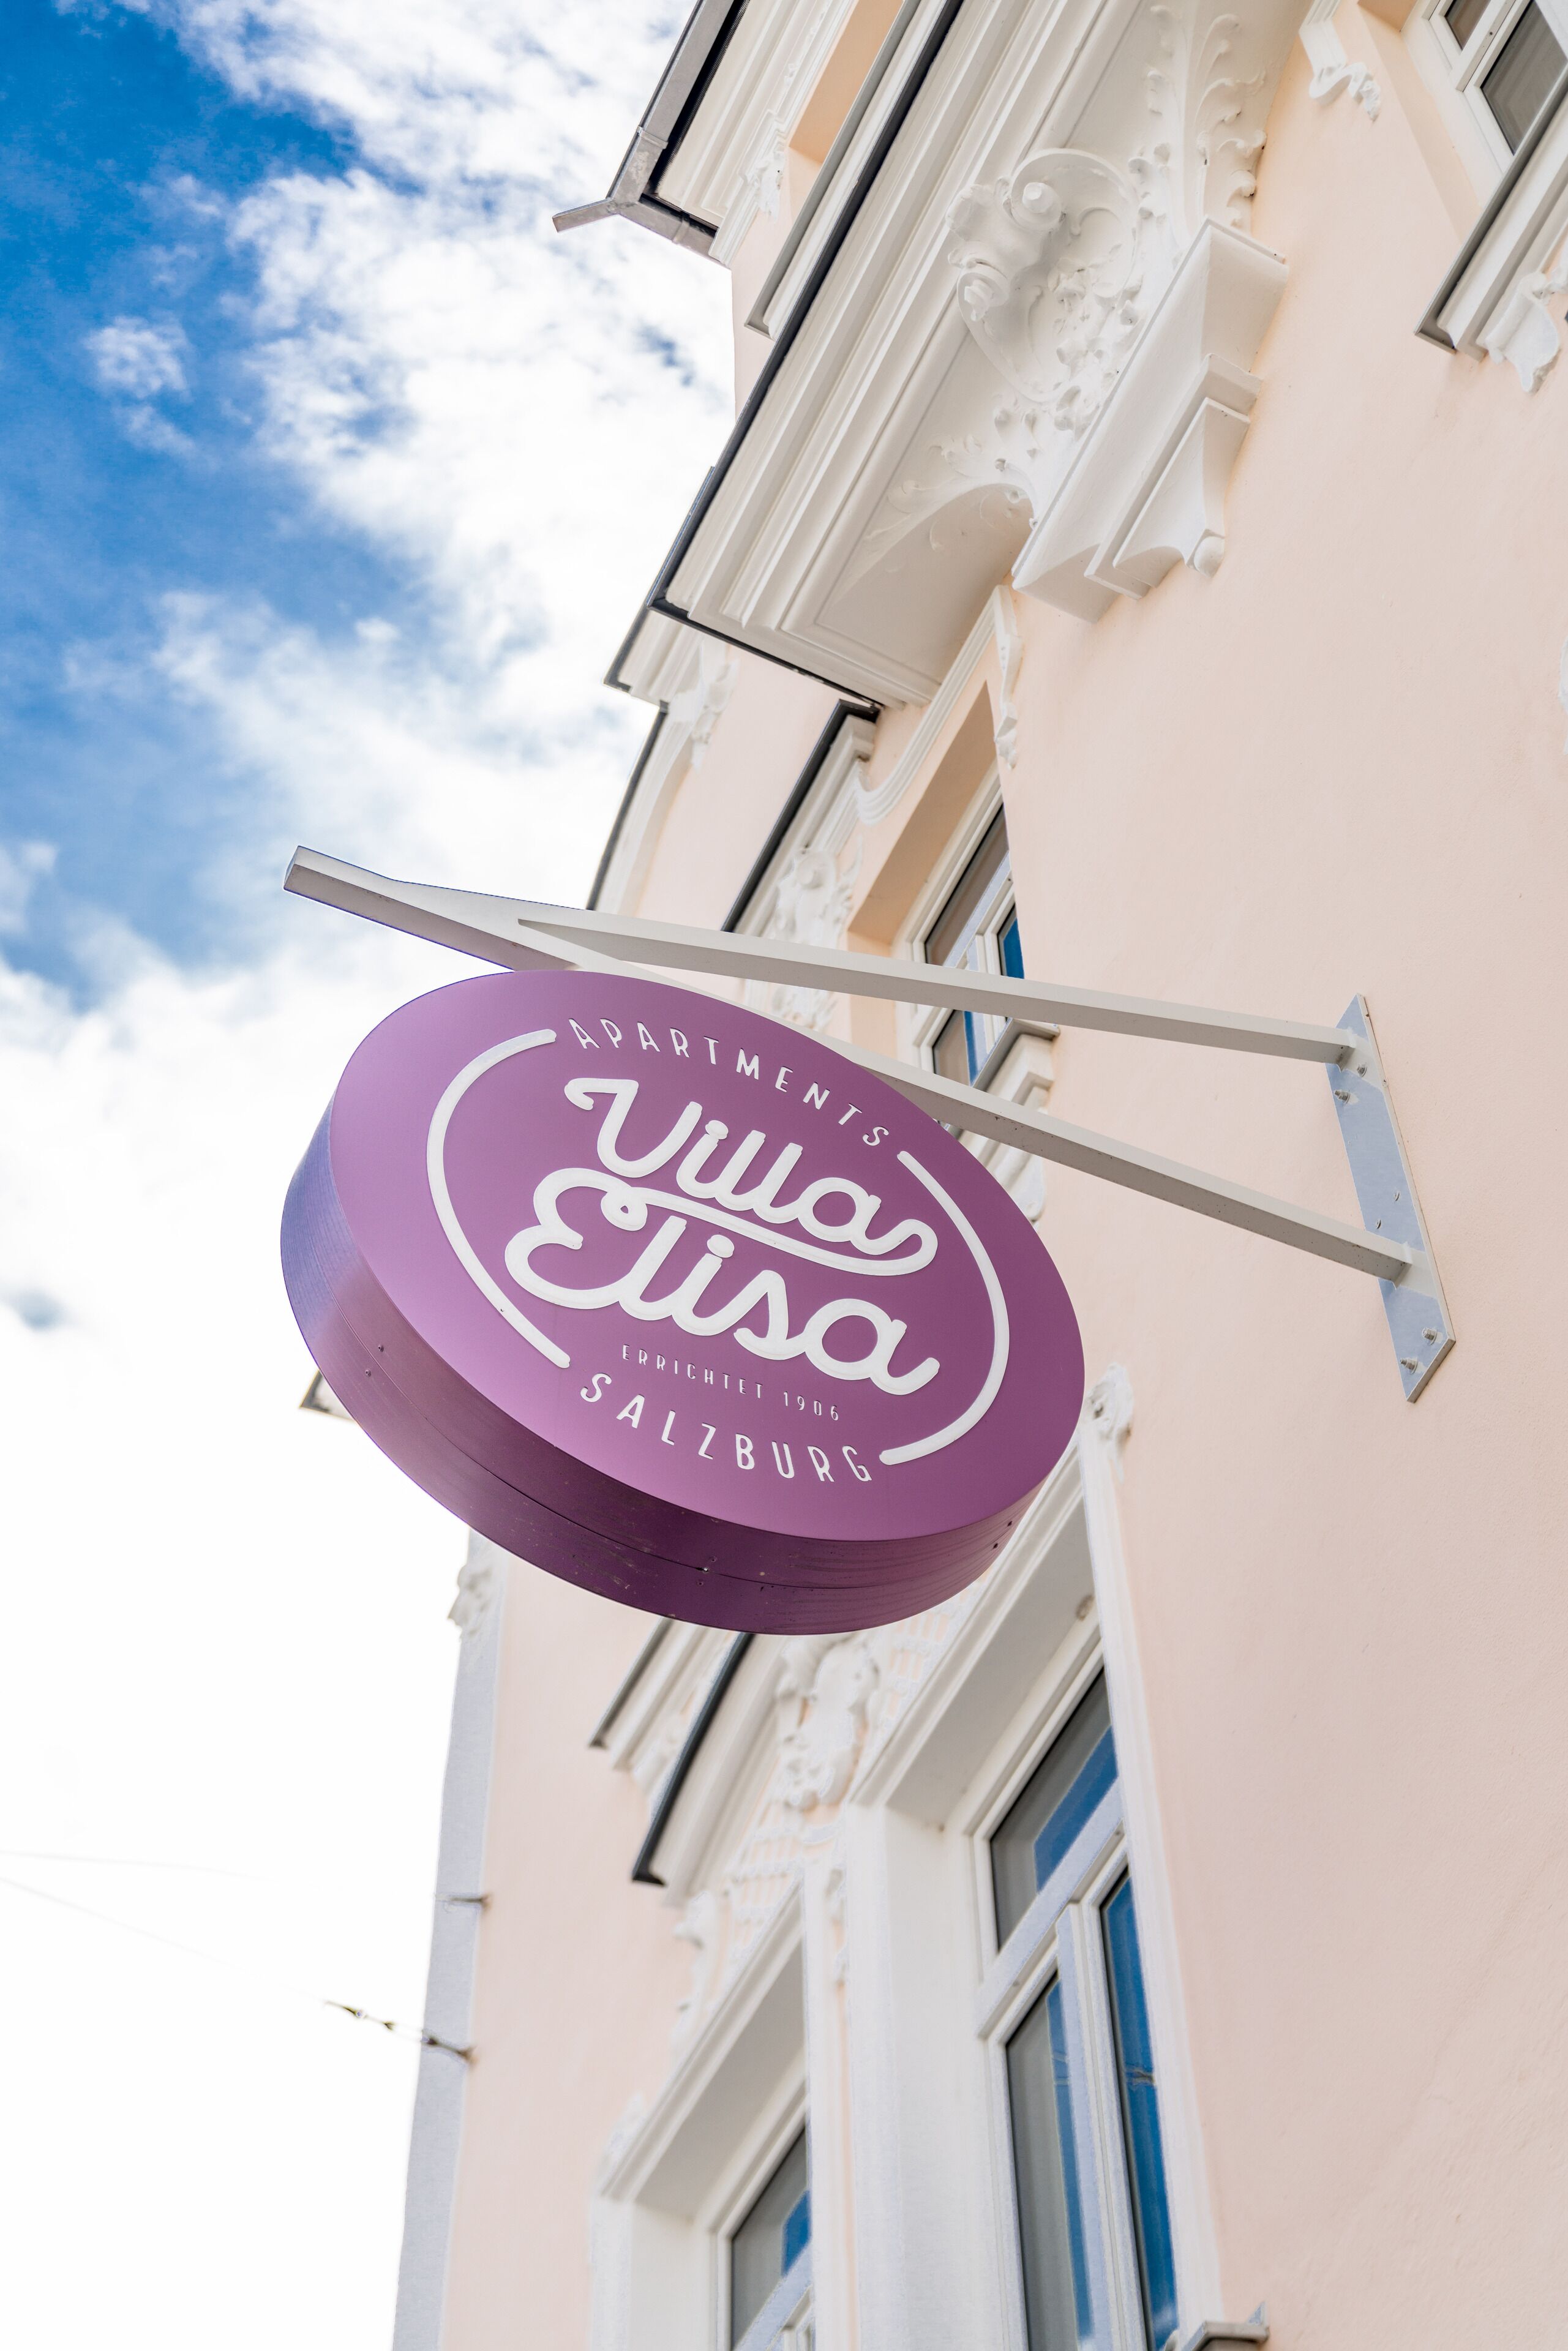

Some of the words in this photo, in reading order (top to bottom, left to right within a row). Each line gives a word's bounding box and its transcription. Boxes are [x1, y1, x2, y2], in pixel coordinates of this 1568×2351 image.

[568, 1018, 890, 1147] APARTMENTS
[564, 1077, 939, 1276] Villa
[505, 1168, 940, 1395] Elisa
[580, 1373, 872, 1482] SALZBURG
[621, 1344, 764, 1399] ERRICHTET
[782, 1392, 839, 1421] 1906
